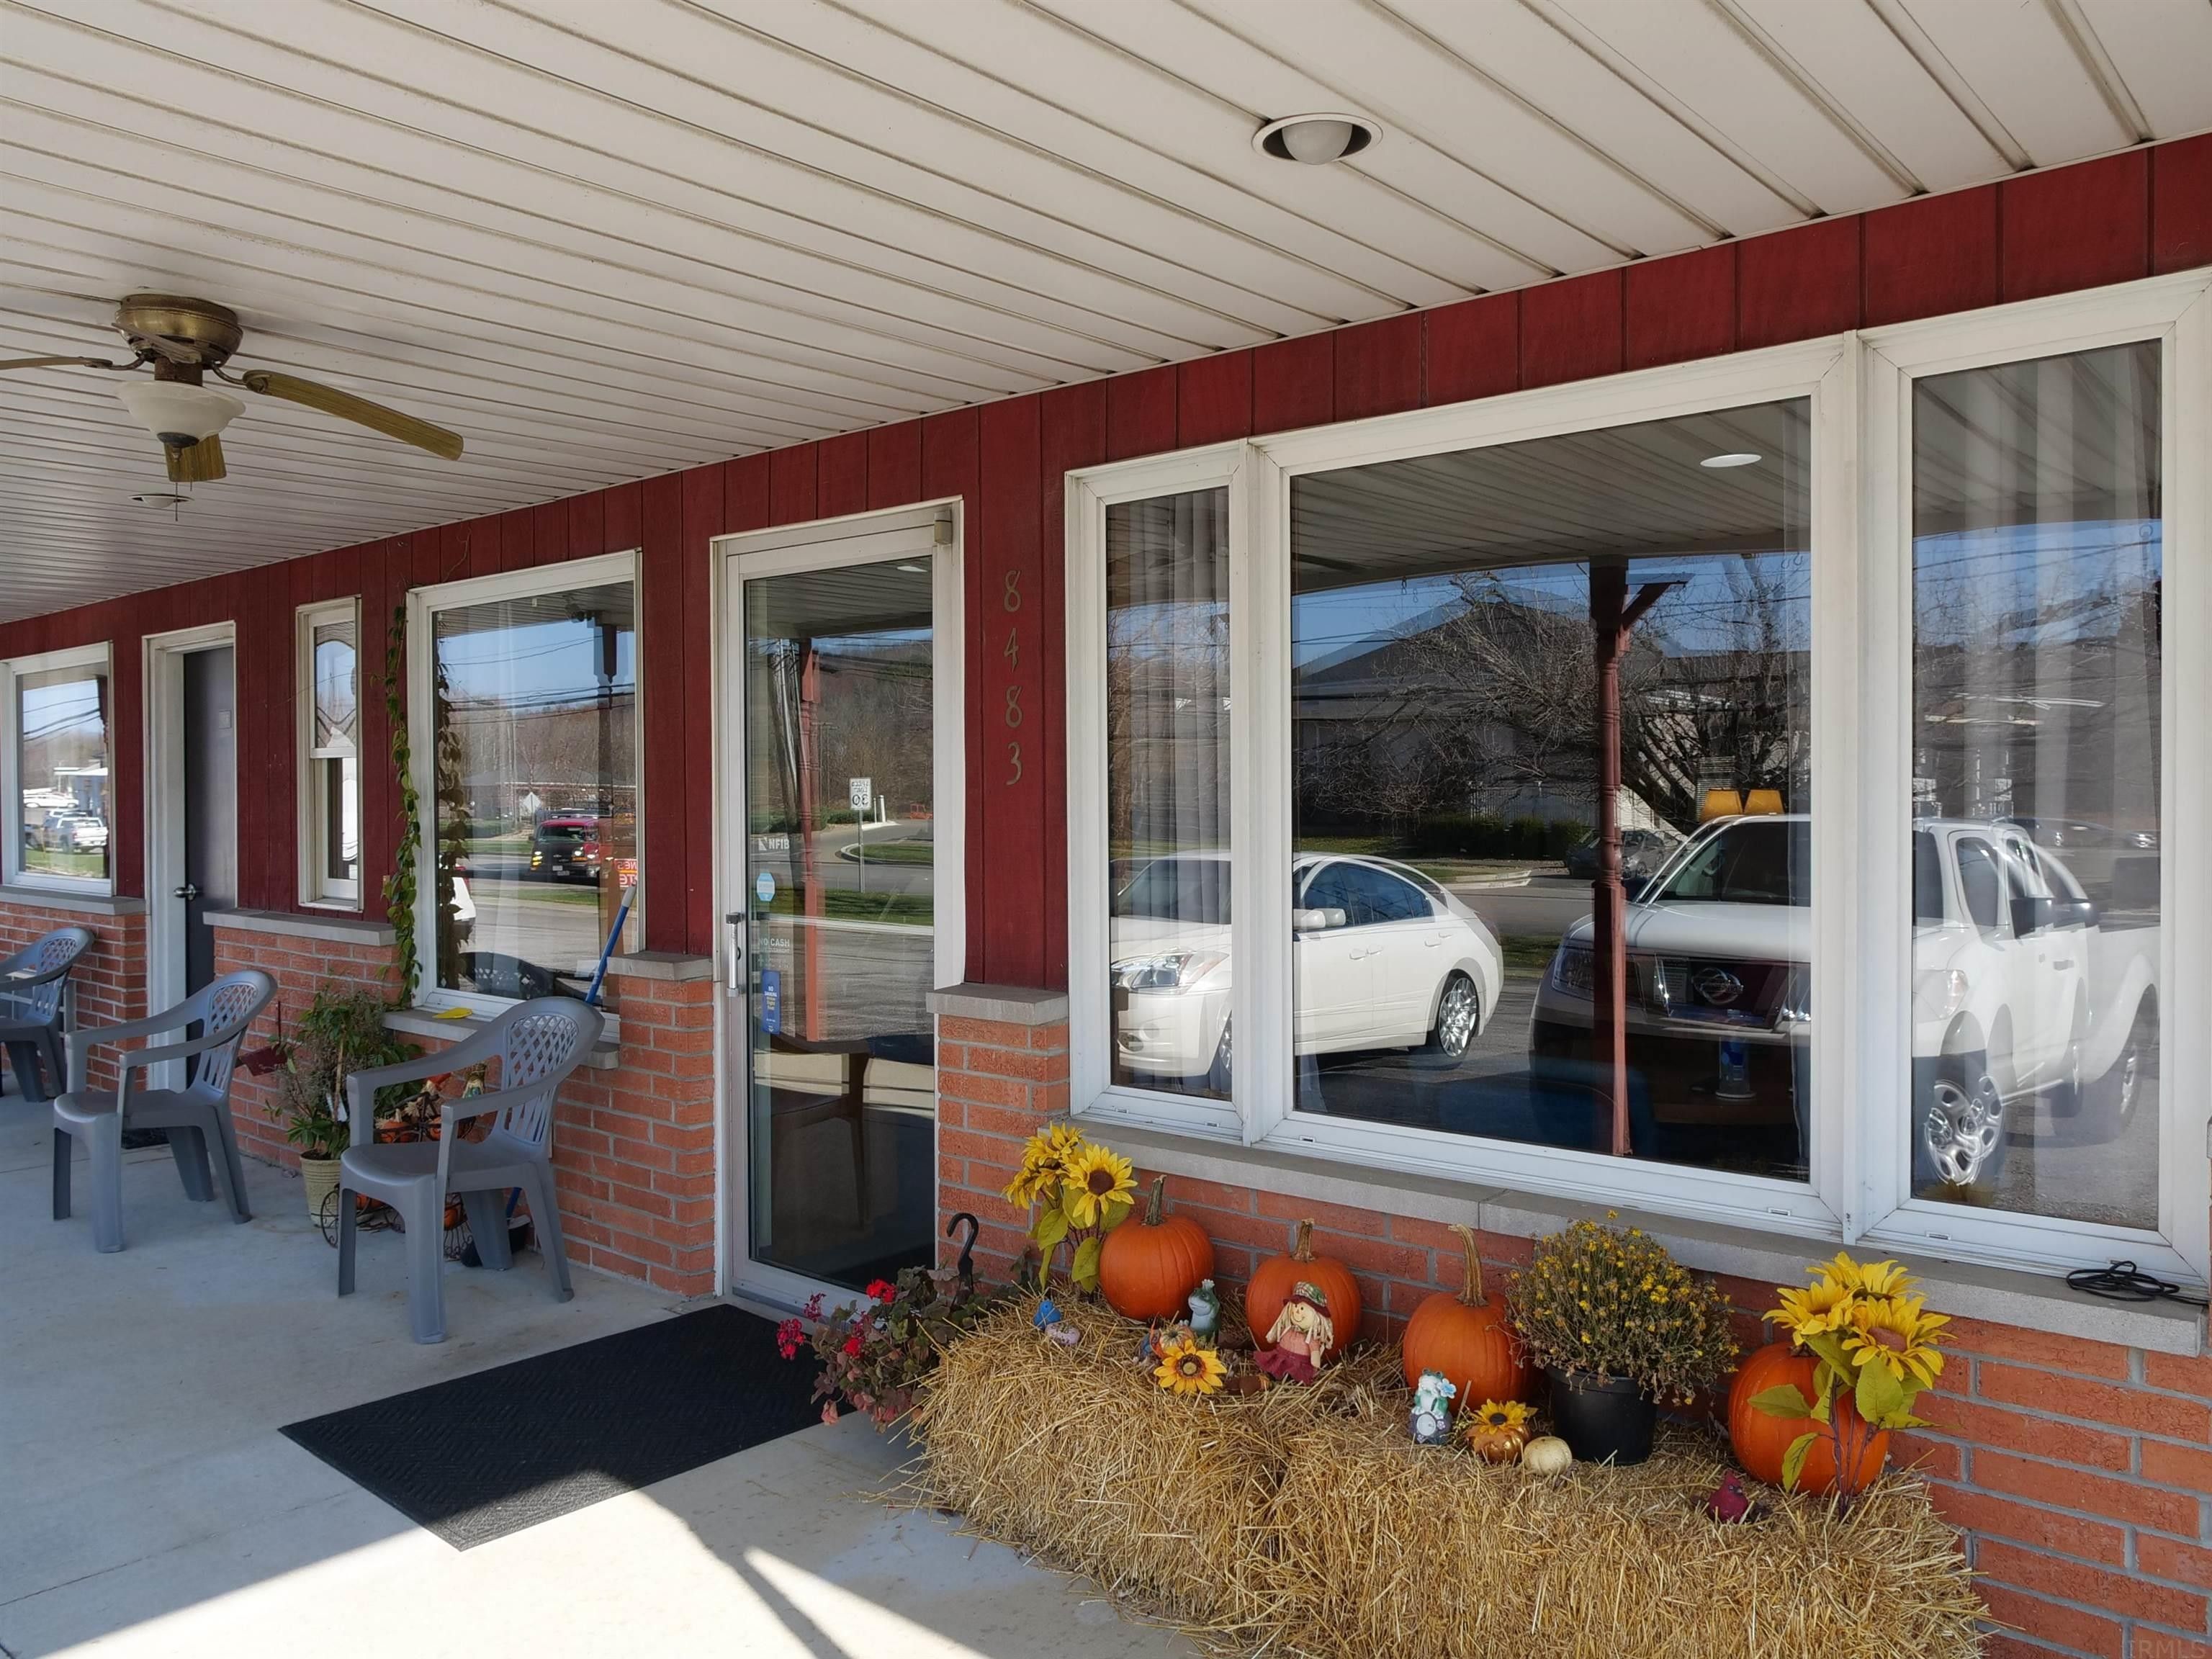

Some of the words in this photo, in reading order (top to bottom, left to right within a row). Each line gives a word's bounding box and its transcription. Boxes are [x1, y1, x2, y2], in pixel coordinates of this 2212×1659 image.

[1004, 570, 1022, 786] 8483
[768, 837, 790, 850] NFIB
[770, 938, 790, 947] CASH
